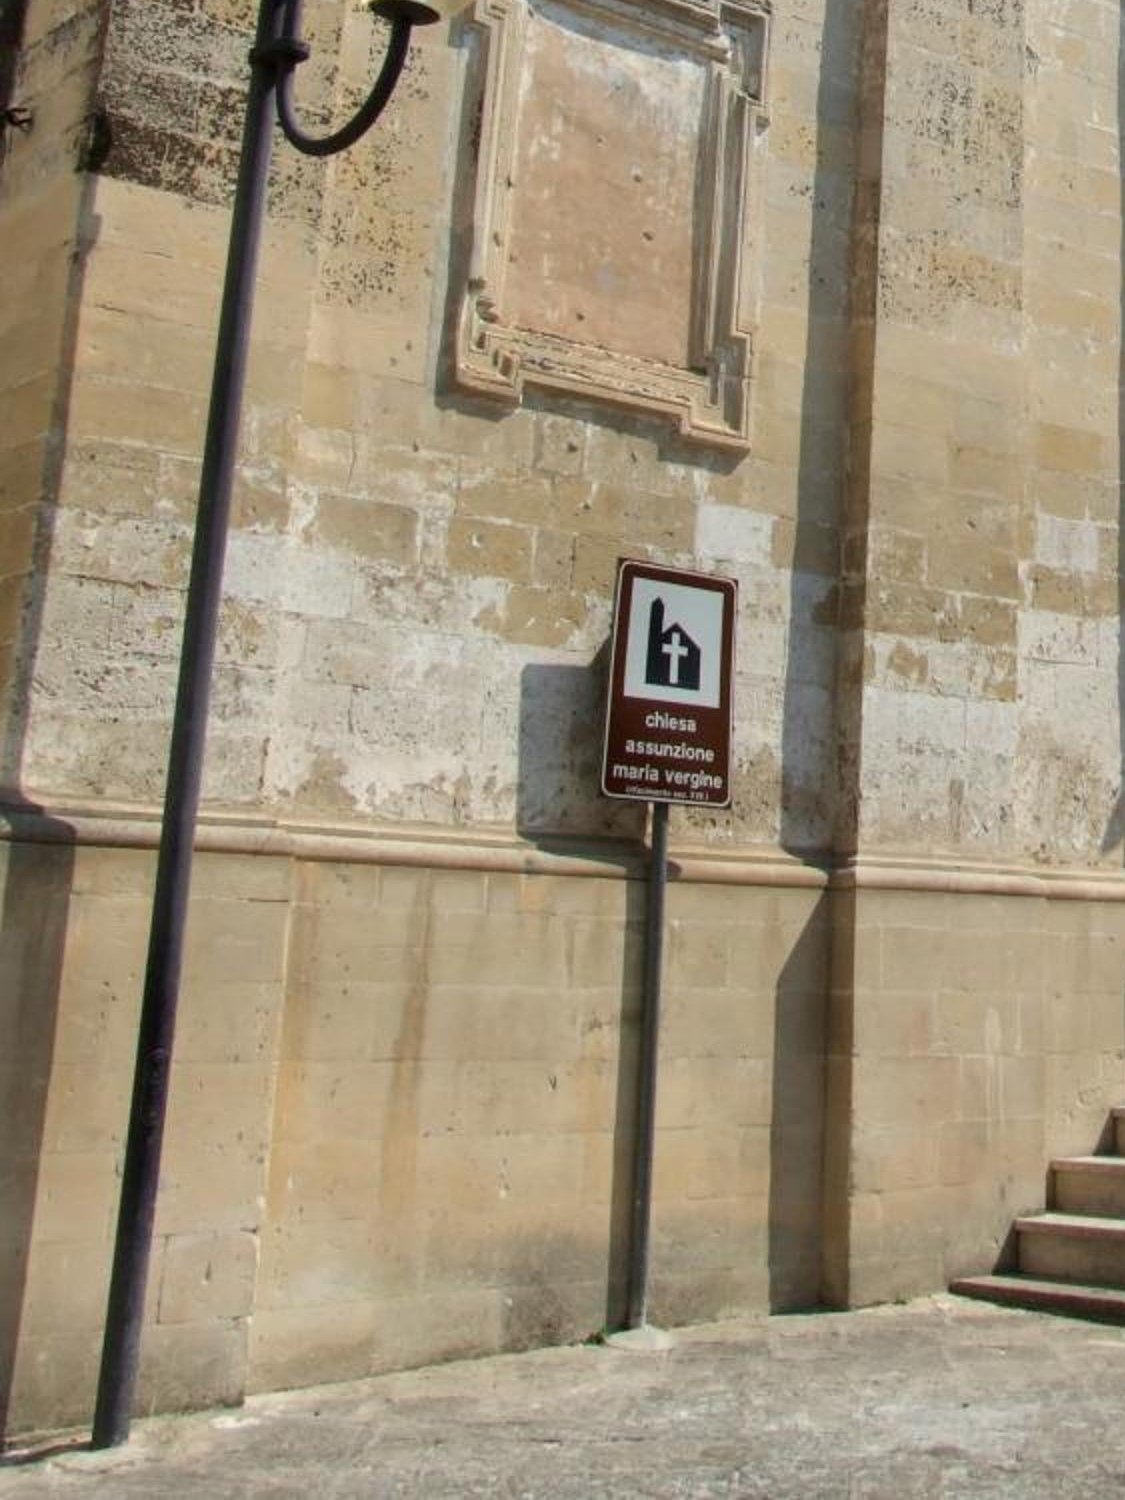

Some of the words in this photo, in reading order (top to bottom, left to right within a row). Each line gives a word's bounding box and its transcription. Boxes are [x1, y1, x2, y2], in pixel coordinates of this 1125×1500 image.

[645, 711, 697, 732] chiesa
[625, 739, 715, 762] assunzione
[613, 763, 659, 782] maria
[665, 769, 723, 789] vergine
